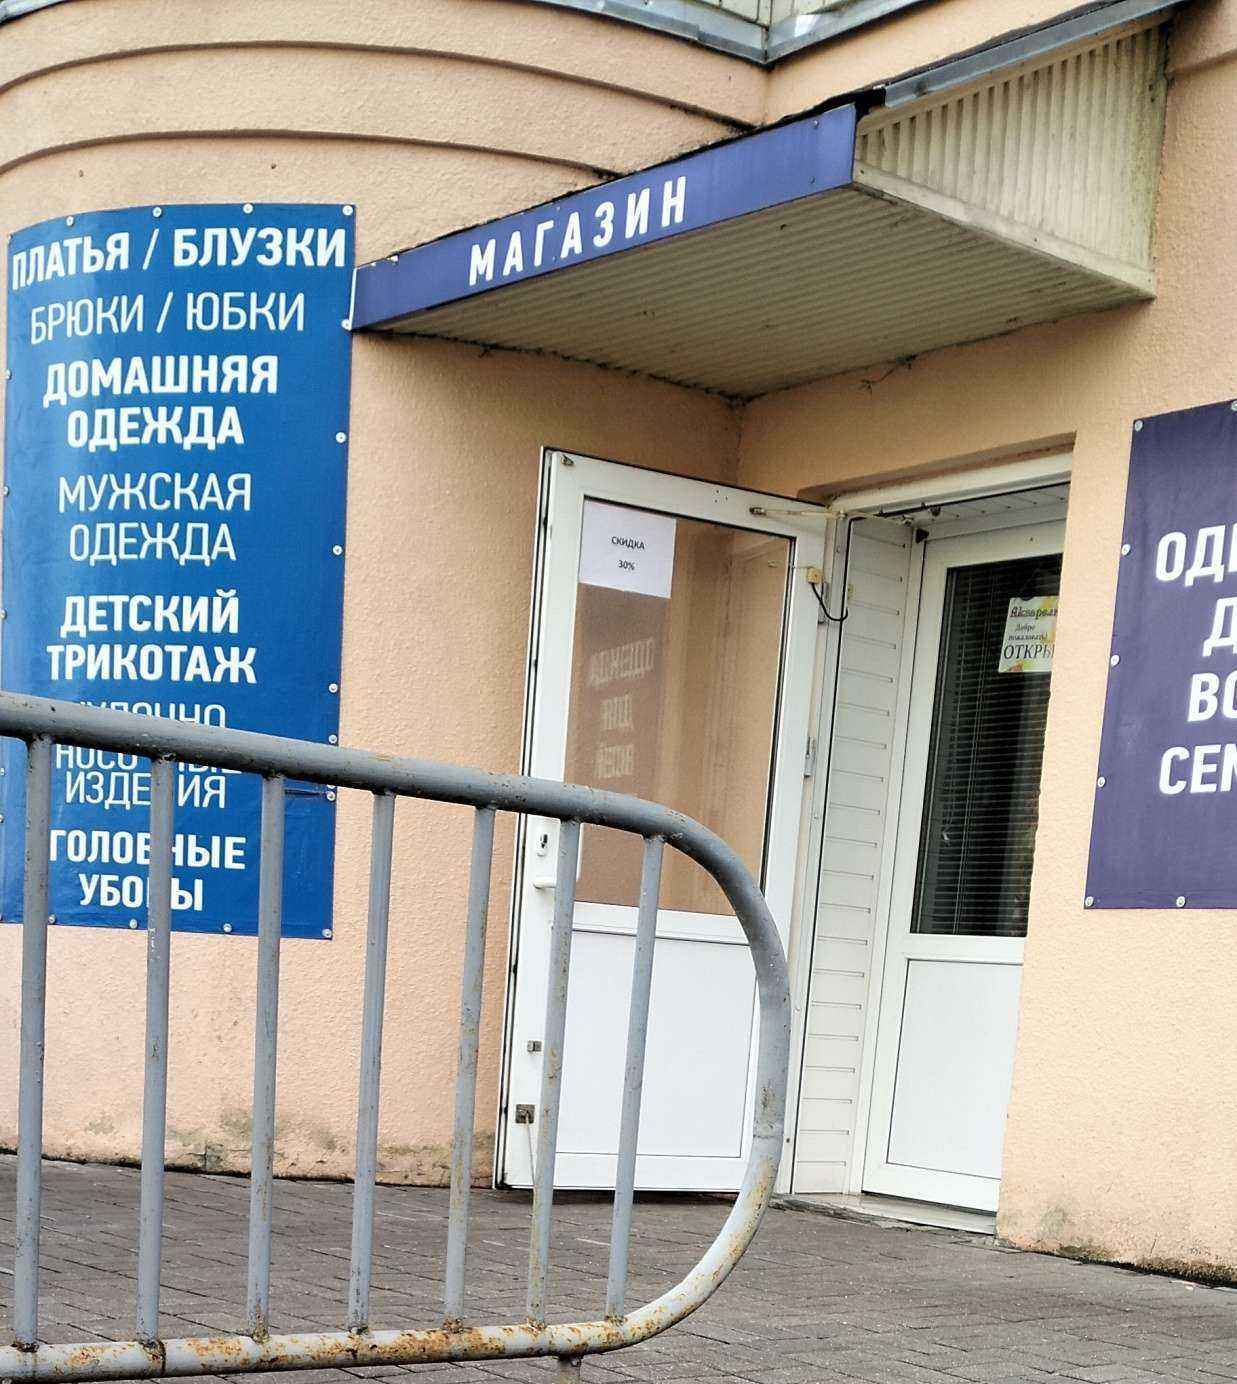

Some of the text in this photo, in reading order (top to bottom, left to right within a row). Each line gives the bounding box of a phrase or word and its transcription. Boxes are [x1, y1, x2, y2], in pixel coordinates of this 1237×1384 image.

[469, 176, 687, 286] МАГАЗИН
[12, 227, 346, 290] ПЛАТЬЯ / БЛУЗКИ
[30, 291, 305, 345] БРЮКИ / ЮБКИ
[43, 355, 279, 408] ДОМАШНЯЯ
[67, 406, 244, 452] ОДЕЖДА
[58, 472, 251, 513] МУЖСКАЯ
[69, 522, 236, 567] ОДЕЖДА
[611, 536, 645, 550] СКИДКА
[618, 559, 636, 571] 30%
[60, 589, 240, 638] ДЕТСКИЙ
[46, 644, 257, 684] ТРИКОТАЖ
[64, 771, 227, 811] ИЗДЕИЯ
[78, 873, 204, 912] УБОЫ
